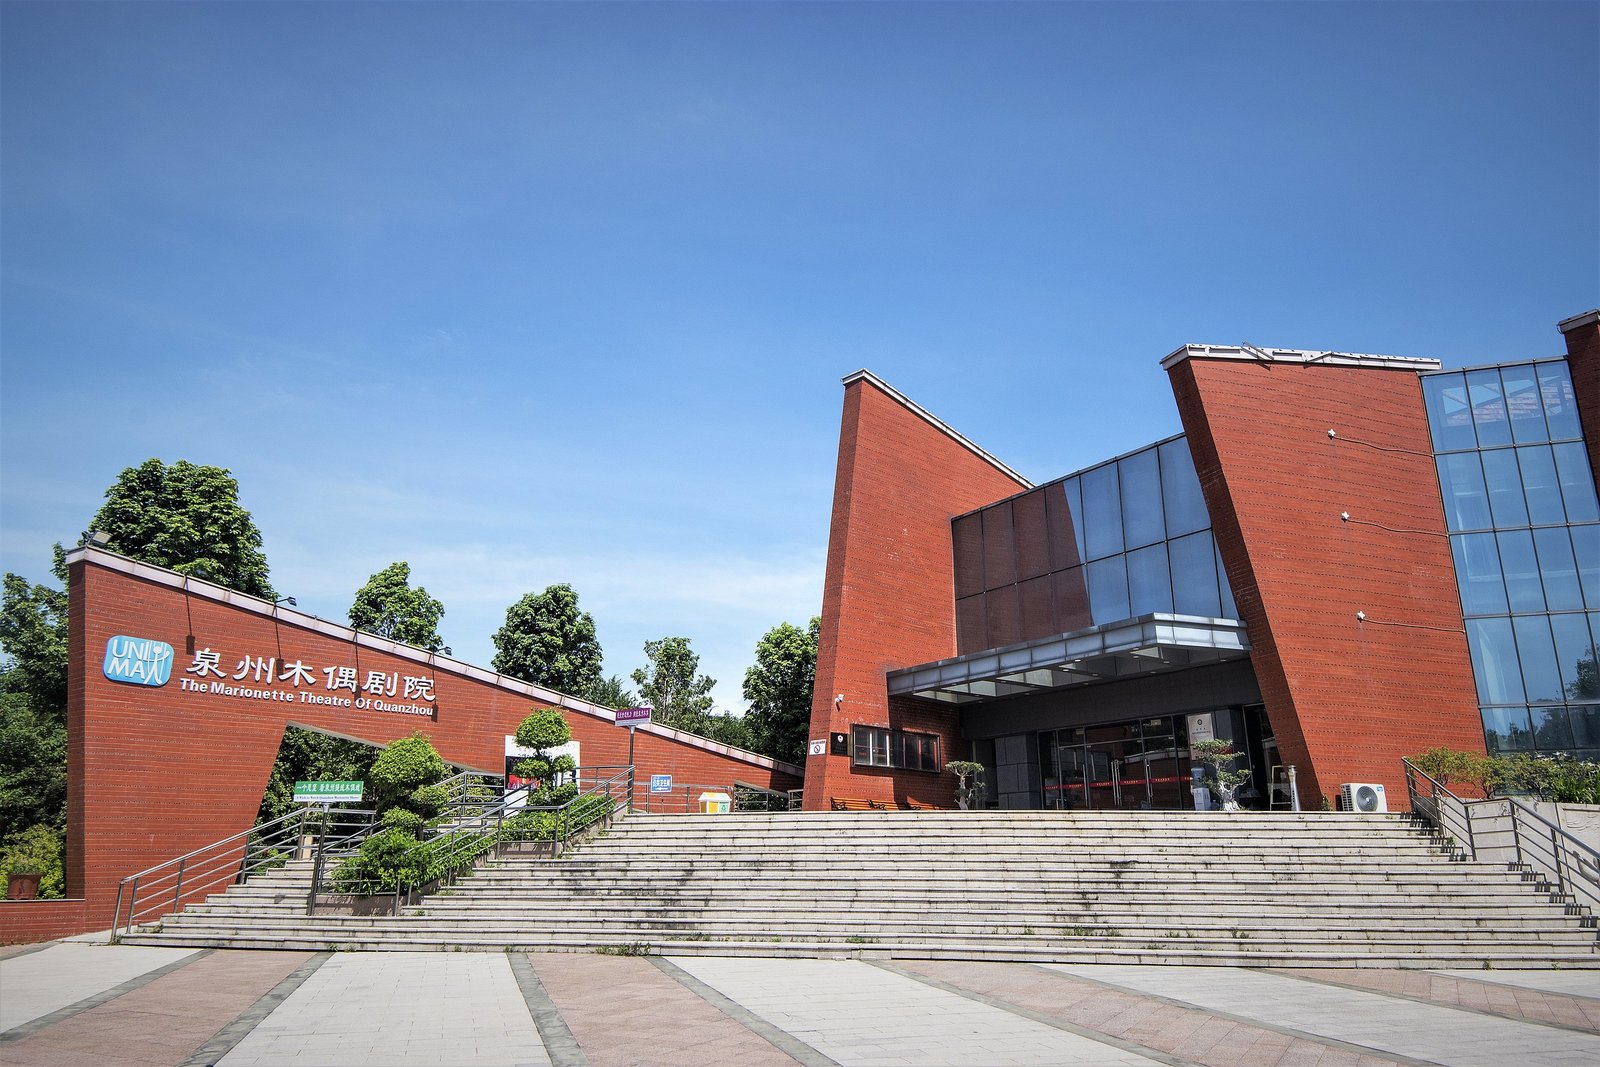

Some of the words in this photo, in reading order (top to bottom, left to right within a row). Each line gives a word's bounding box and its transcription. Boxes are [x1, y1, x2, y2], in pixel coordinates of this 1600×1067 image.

[112, 639, 150, 661] UNI
[186, 647, 437, 702] 泉州木偶剧院
[180, 678, 208, 693] The
[210, 681, 295, 702] Marionette
[299, 691, 352, 708] Theatre
[355, 697, 372, 710] Of
[373, 699, 434, 716] Quanzhou
